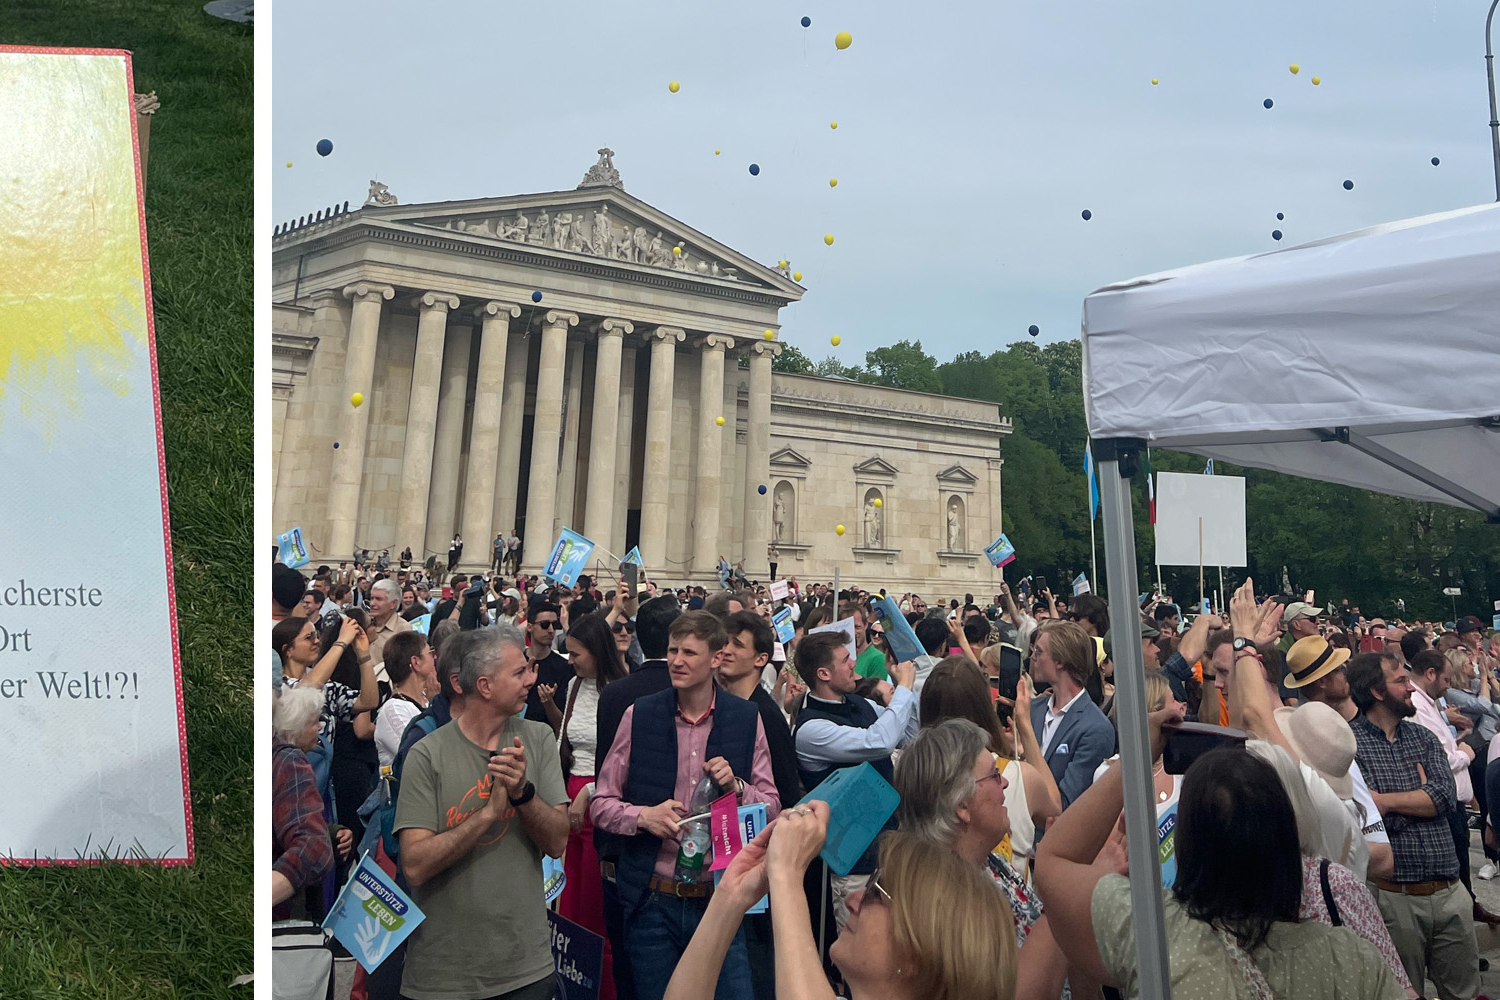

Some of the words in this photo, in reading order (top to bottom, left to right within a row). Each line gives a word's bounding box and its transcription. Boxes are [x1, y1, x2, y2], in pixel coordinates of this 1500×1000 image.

[36, 671, 140, 700] Welt!?!
[1158, 817, 1175, 839] ÜTZE
[358, 871, 404, 913] UNTERSTÜTZE
[367, 899, 398, 927] LEBEN
[549, 920, 571, 954] ter
[557, 953, 583, 985] Liebe
